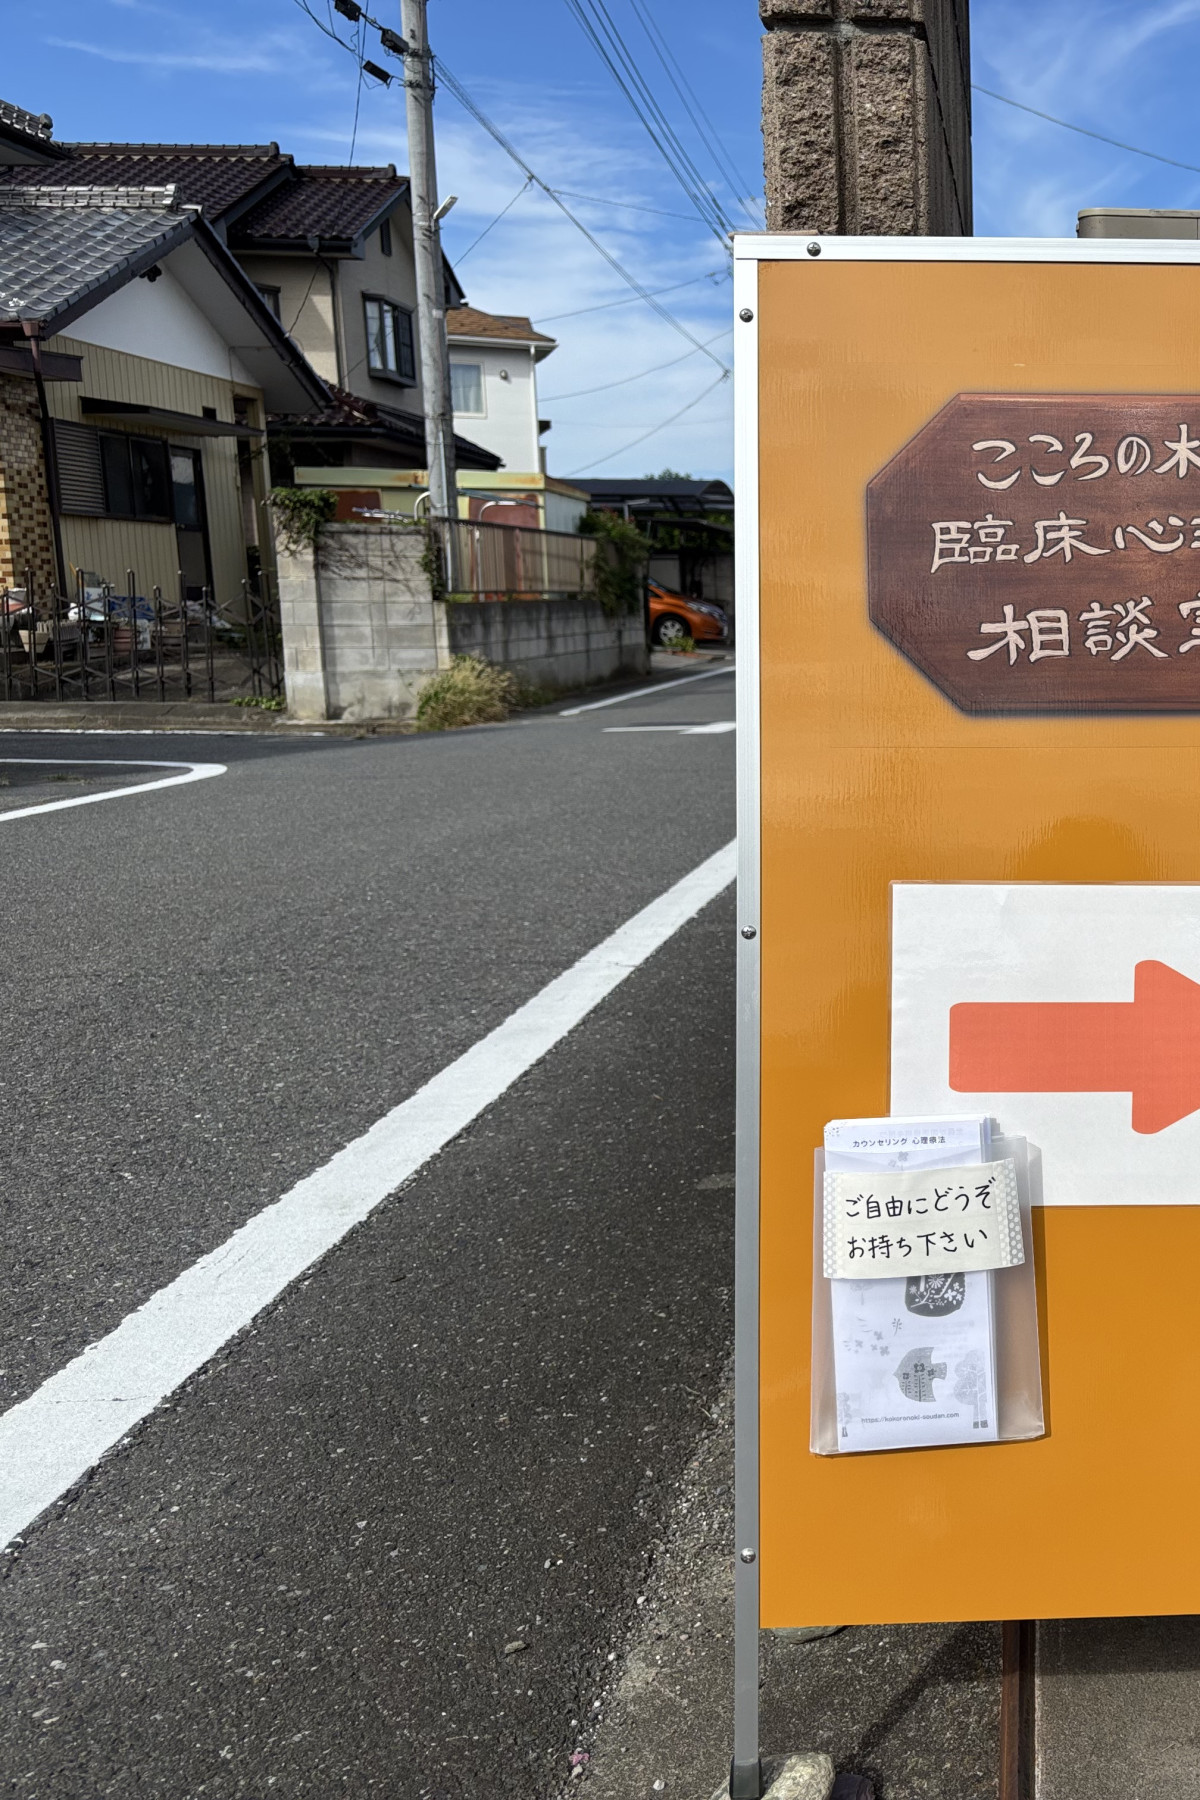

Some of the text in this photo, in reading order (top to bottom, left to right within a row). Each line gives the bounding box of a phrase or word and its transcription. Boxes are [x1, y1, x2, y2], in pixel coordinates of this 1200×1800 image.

[852, 1136, 946, 1148] カウンセリング 心理療法
[846, 1176, 996, 1218] ご自由にどうぞ
[847, 1229, 988, 1258] お持ち下さい
